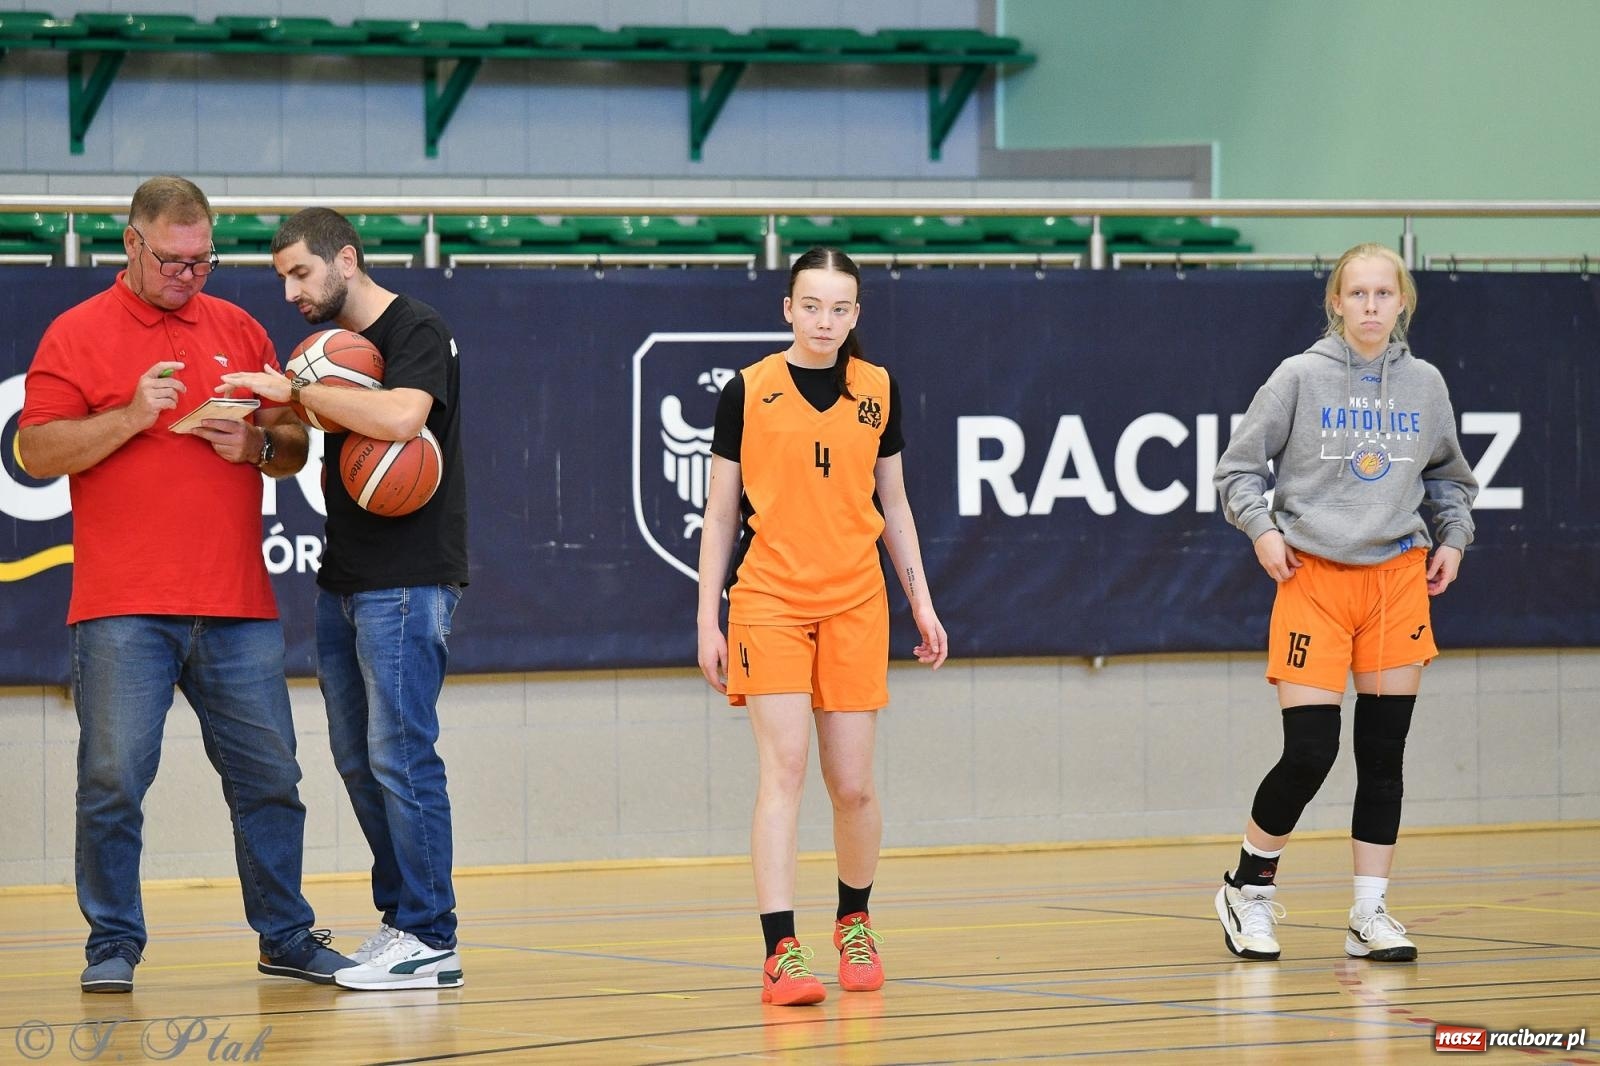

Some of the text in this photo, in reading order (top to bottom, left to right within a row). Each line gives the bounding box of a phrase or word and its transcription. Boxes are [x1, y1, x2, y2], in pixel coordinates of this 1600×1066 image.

[1349, 396, 1395, 410] MKS MS
[350, 443, 374, 483] molten
[814, 441, 831, 478] 4
[956, 411, 1523, 517] RACIZ
[739, 642, 750, 678] 4
[1286, 631, 1312, 669] 15
